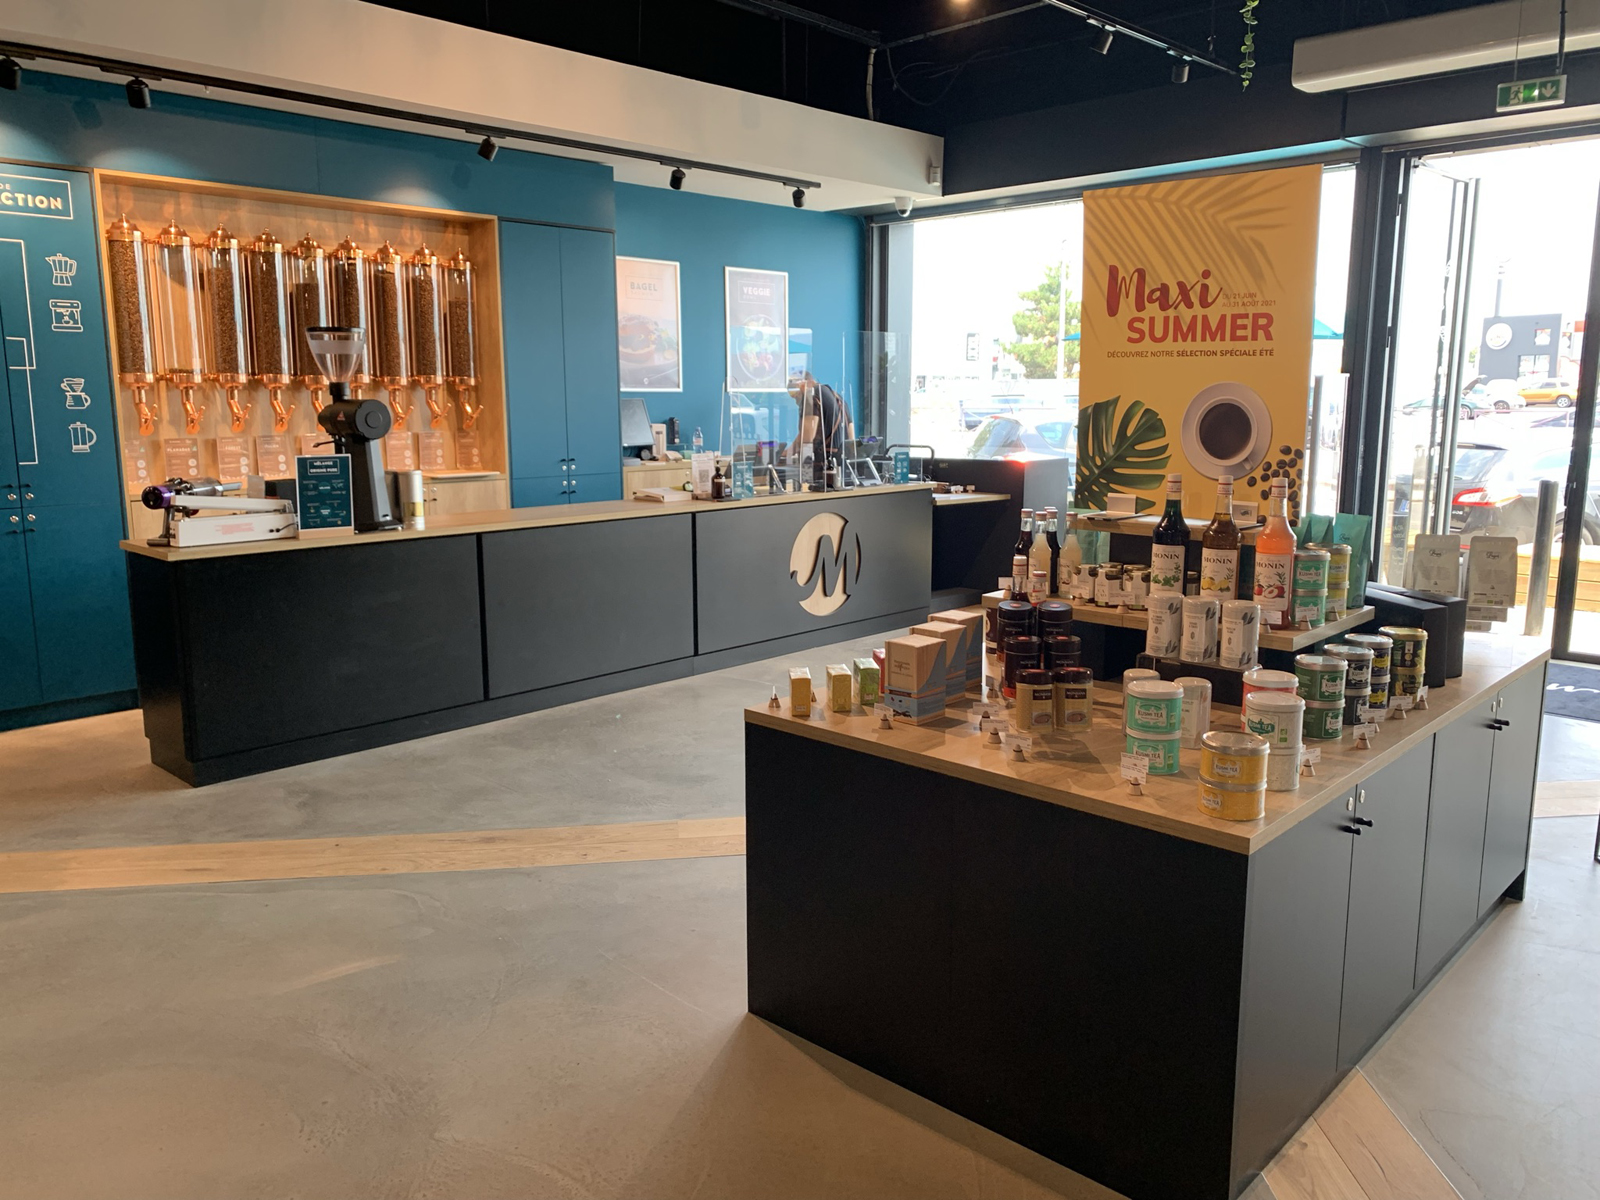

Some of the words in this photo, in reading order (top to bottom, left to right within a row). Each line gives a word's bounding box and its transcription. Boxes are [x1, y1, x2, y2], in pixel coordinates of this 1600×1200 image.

[0, 191, 62, 210] CTION
[630, 281, 658, 291] BAGEL
[743, 286, 771, 296] VEGGIE
[1106, 264, 1223, 317] Maxi
[1241, 299, 1260, 307] AOÛT
[1126, 312, 1274, 344] SUMMER
[1107, 350, 1149, 358] DÉCOUVREZ
[1150, 350, 1175, 358] NOTRE
[1176, 349, 1218, 357] SÉLECTION
[1219, 348, 1258, 357] SPÉCIALE
[1259, 347, 1275, 357] ÉTÉ
[1255, 561, 1286, 569] MONIN
